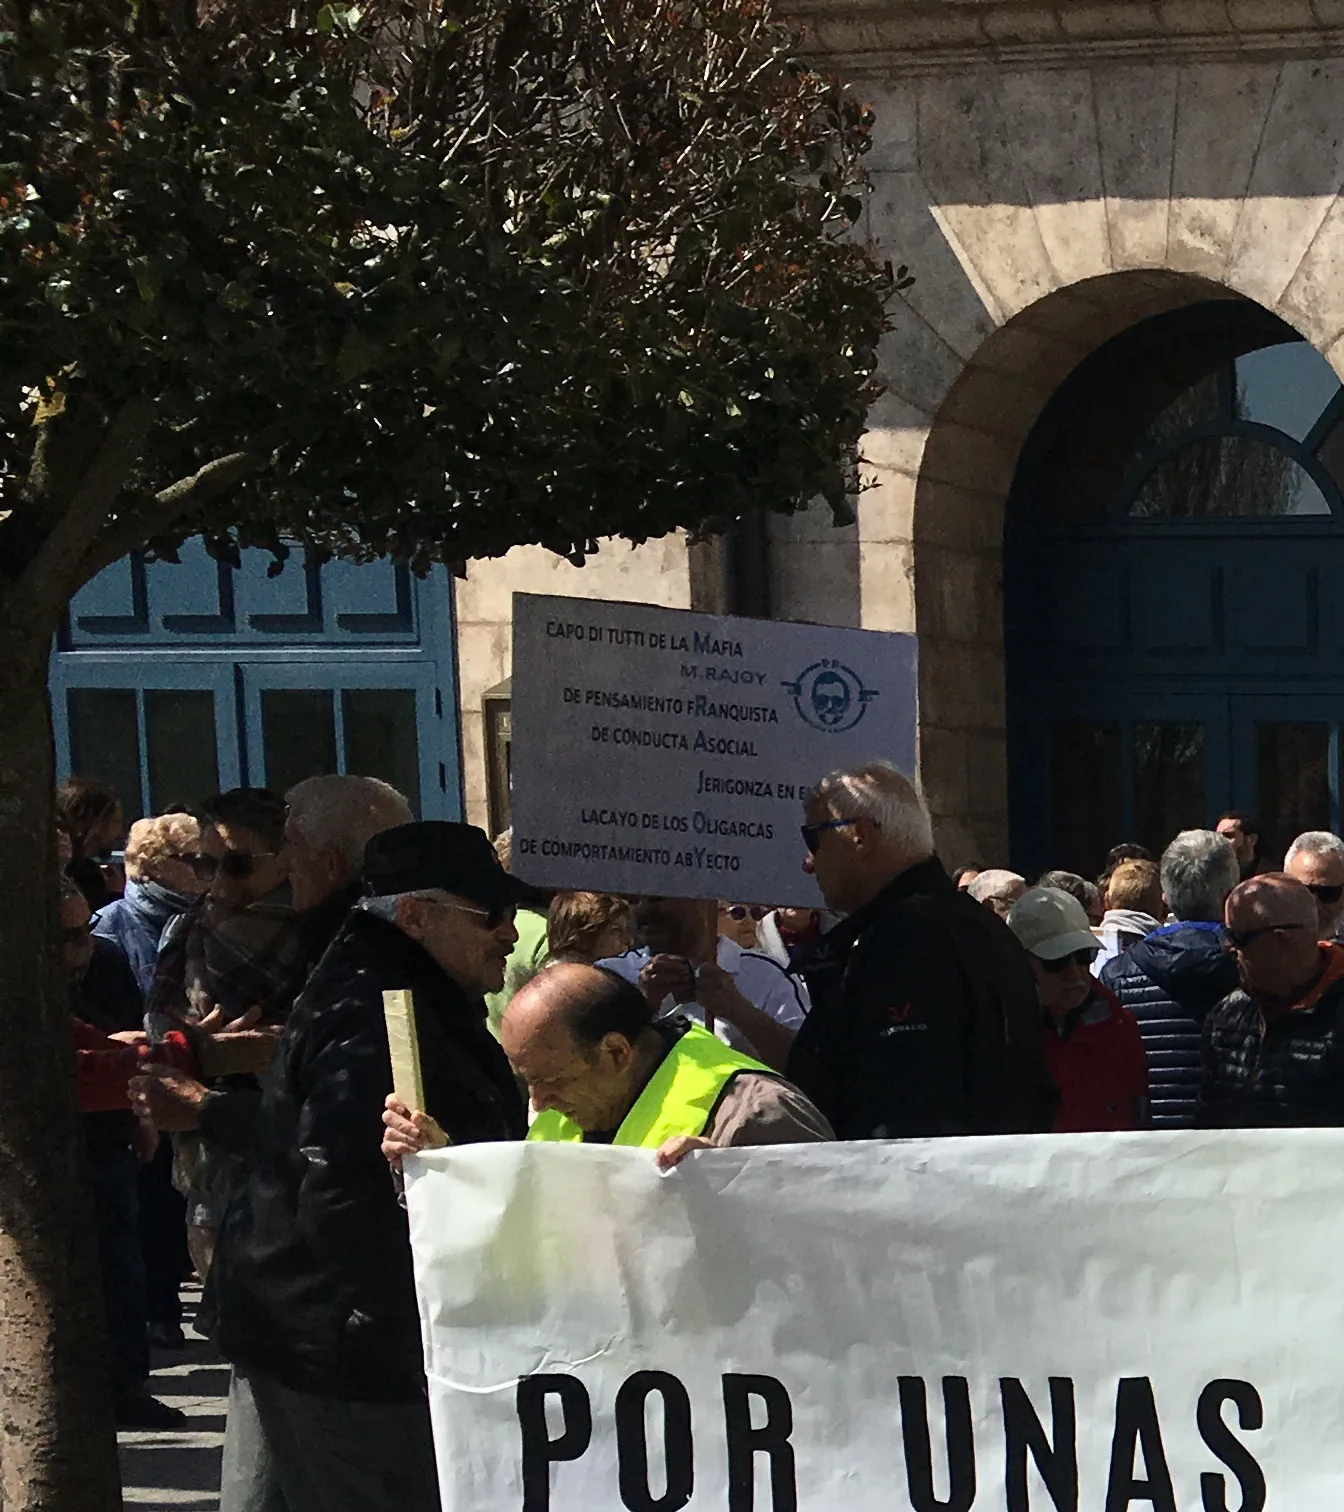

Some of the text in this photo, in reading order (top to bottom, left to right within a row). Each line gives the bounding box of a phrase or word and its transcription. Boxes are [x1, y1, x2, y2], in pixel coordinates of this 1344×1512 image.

[547, 620, 743, 657] CAPO DI TUTTI DE LA MAFIA
[705, 667, 767, 686] RAJOY
[563, 687, 778, 723] DE PENSAMIENTO FRANQUISTA
[591, 725, 758, 757] DE CONDUCTA ASOCIAL
[697, 769, 773, 799] JERIGONZA
[777, 783, 795, 800] EN
[581, 809, 774, 840] LACAYO DE LOS OLIGARCAS
[520, 837, 740, 871] DE COMPORTAMIENTO ABYECTO
